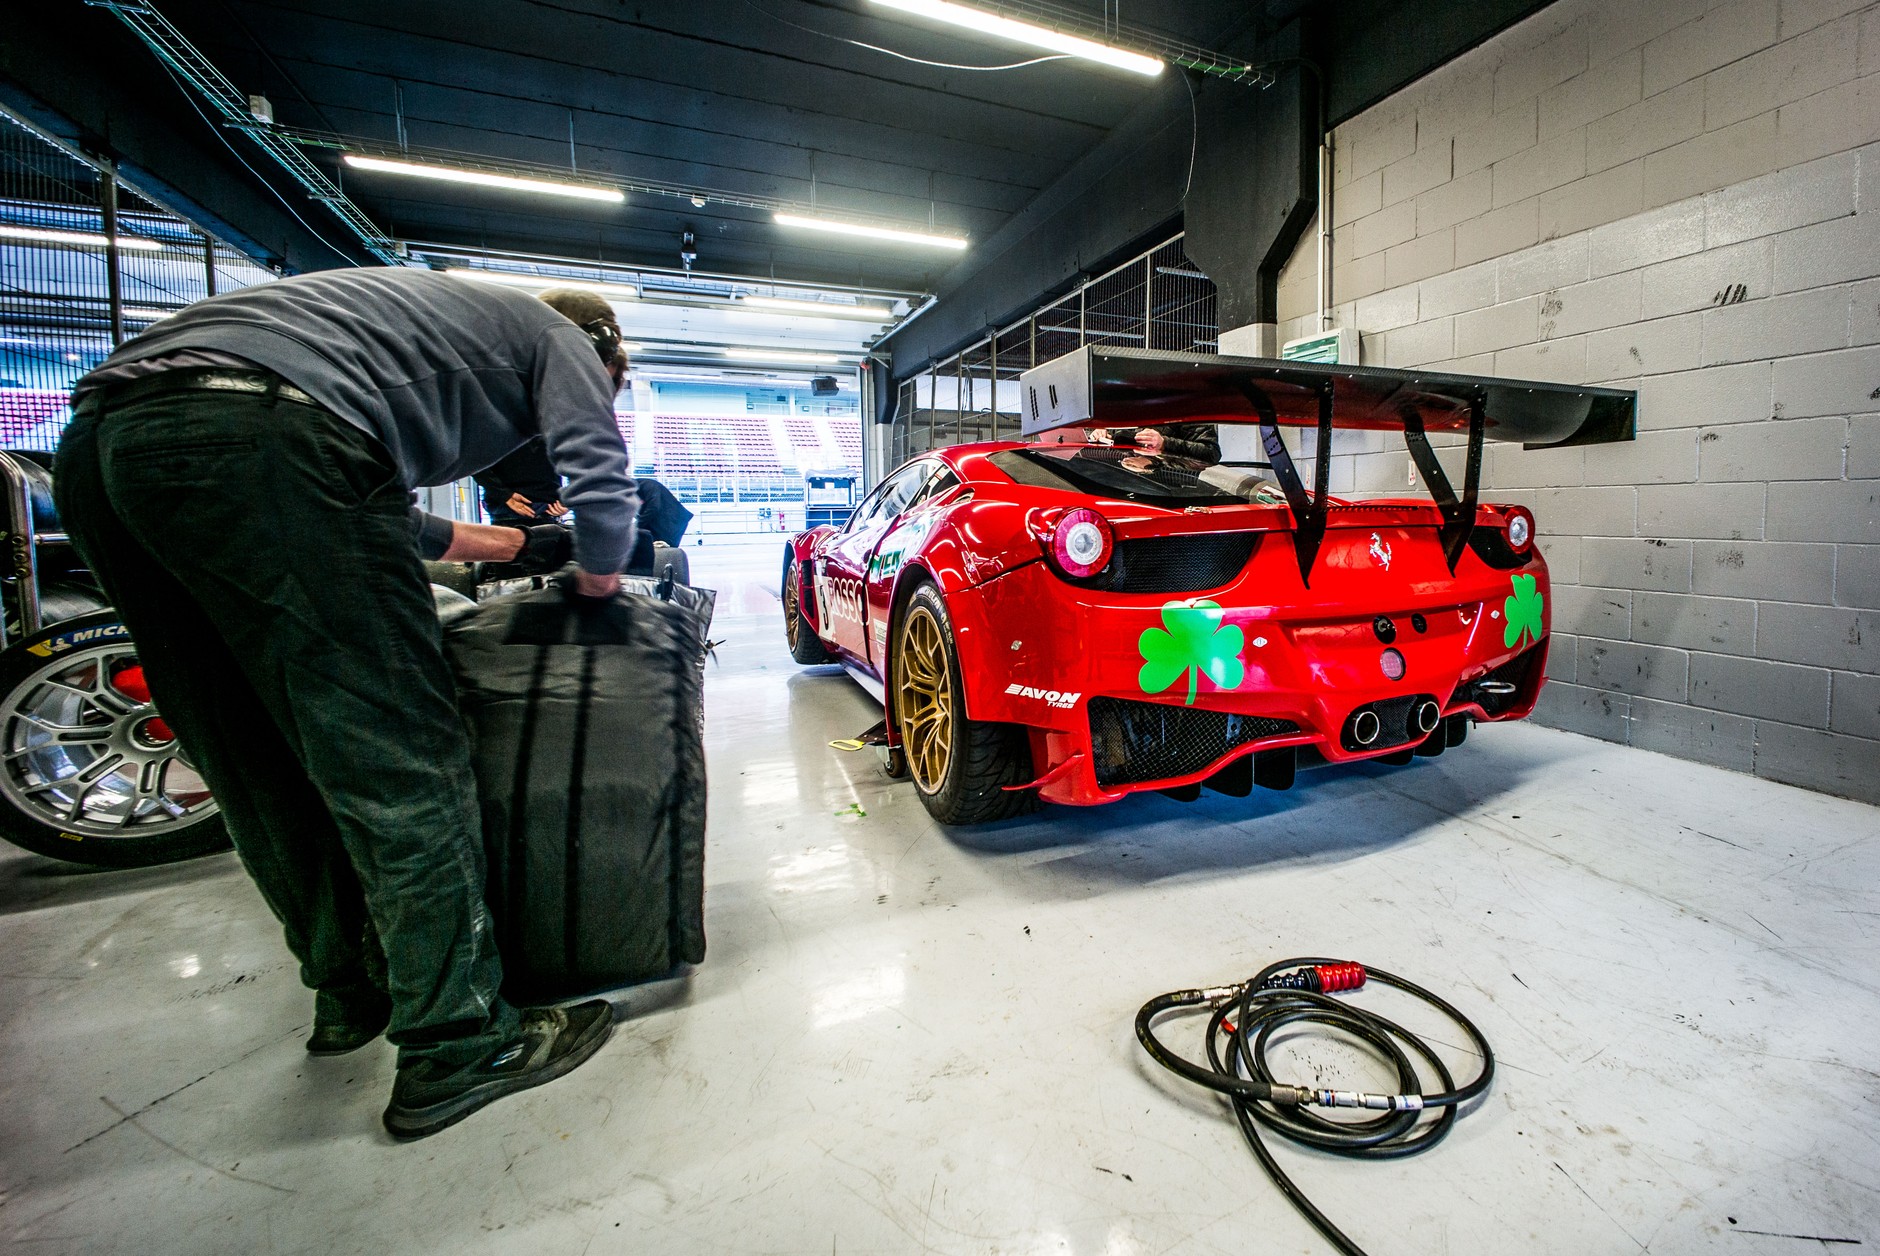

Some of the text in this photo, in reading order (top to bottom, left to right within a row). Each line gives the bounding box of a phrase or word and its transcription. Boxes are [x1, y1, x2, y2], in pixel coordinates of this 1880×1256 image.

[73, 625, 129, 642] MICH
[1020, 686, 1081, 703] AVON
[1047, 701, 1074, 709] TYRES
